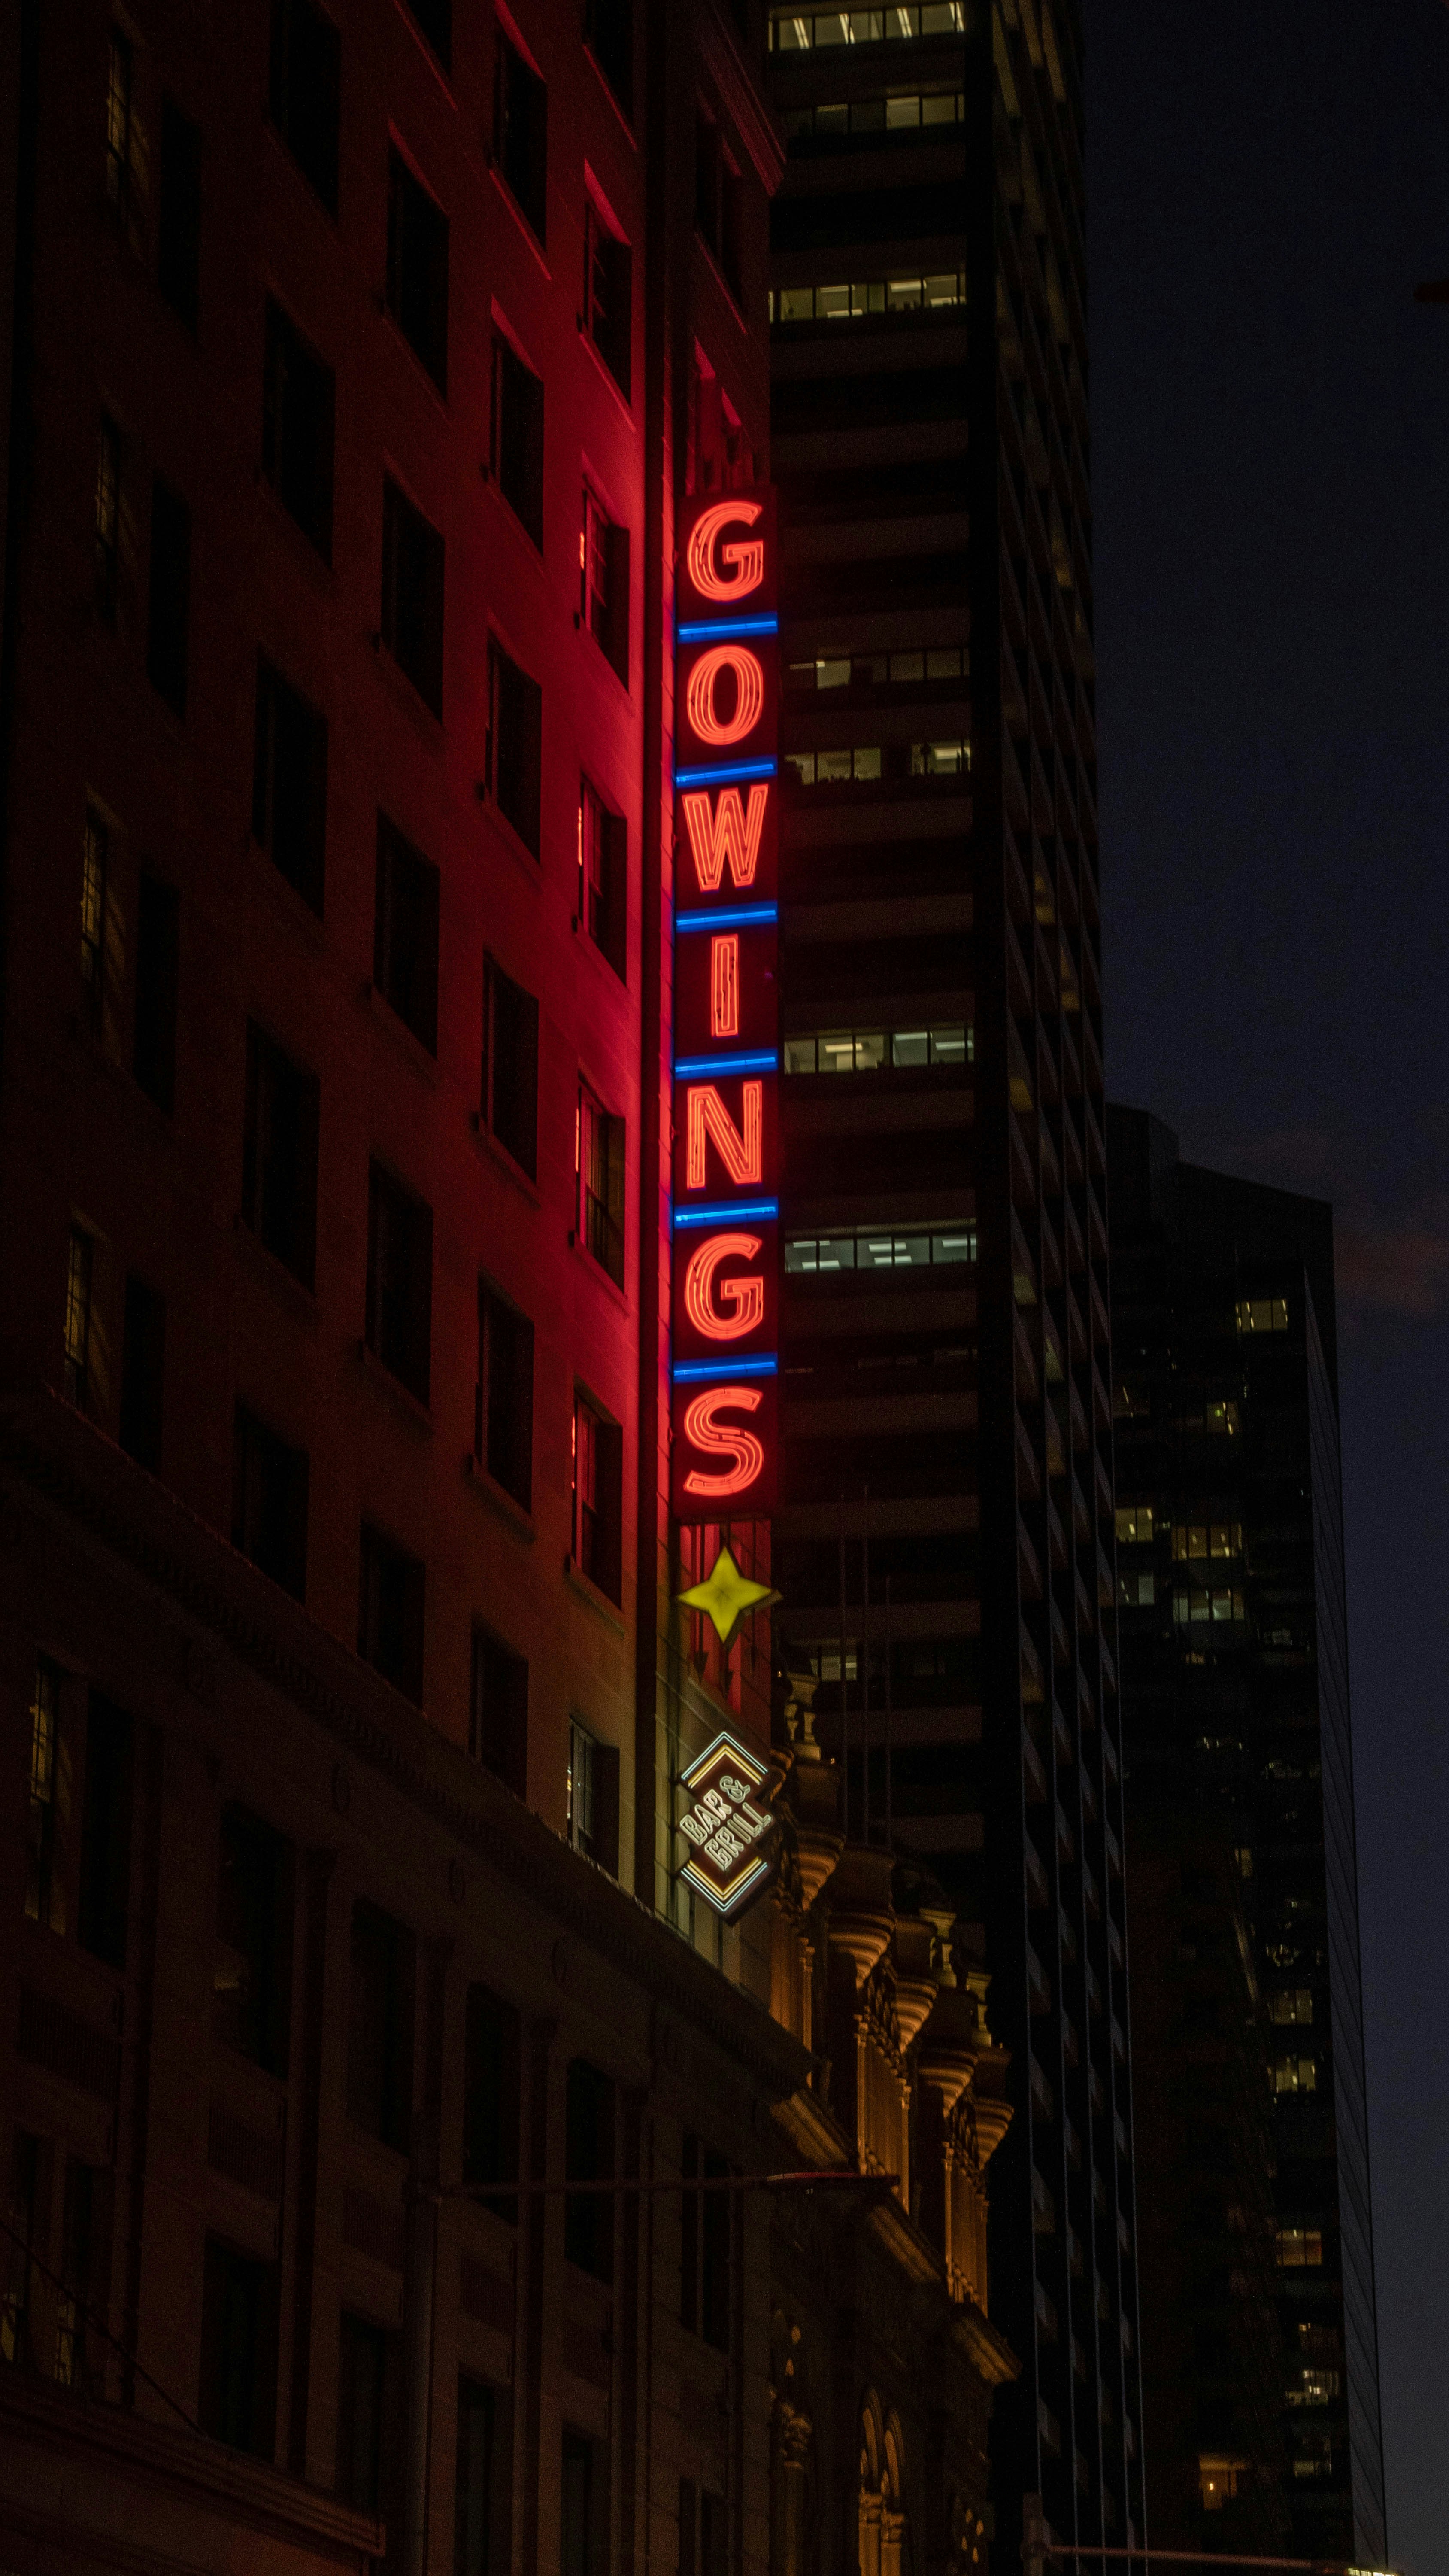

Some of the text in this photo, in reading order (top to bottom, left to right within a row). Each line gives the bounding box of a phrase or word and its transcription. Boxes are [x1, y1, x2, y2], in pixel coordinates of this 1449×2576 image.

[682, 501, 768, 1496] GOWINGS
[679, 1776, 750, 1846] BAR &
[704, 1802, 772, 1872] GRILL
